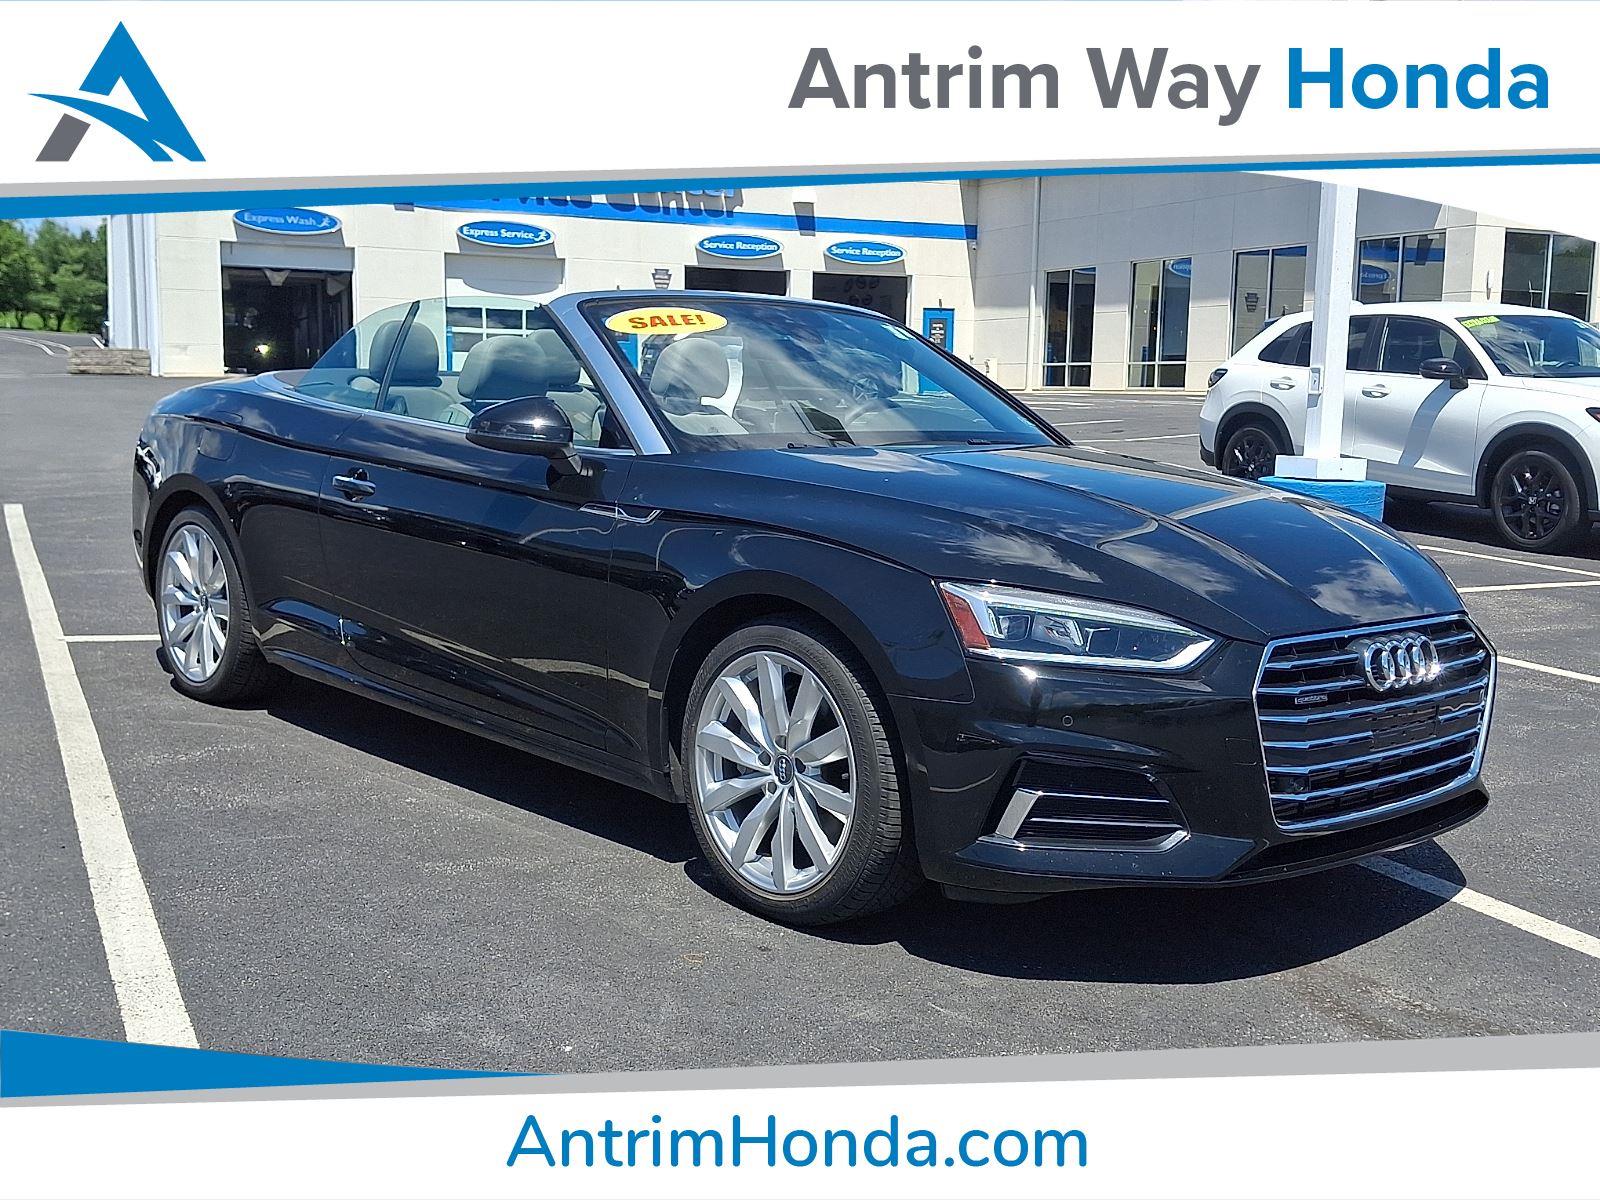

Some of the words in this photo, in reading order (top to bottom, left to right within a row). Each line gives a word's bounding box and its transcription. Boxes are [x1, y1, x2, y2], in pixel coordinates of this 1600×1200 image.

[244, 213, 284, 224] Express
[286, 215, 316, 226] Wash
[462, 226, 499, 237] Express
[501, 229, 535, 239] Service
[703, 240, 735, 249] Service
[736, 242, 778, 251] Reception
[831, 246, 861, 255] Service
[862, 248, 901, 257] Reception
[628, 314, 706, 329] SALE!
